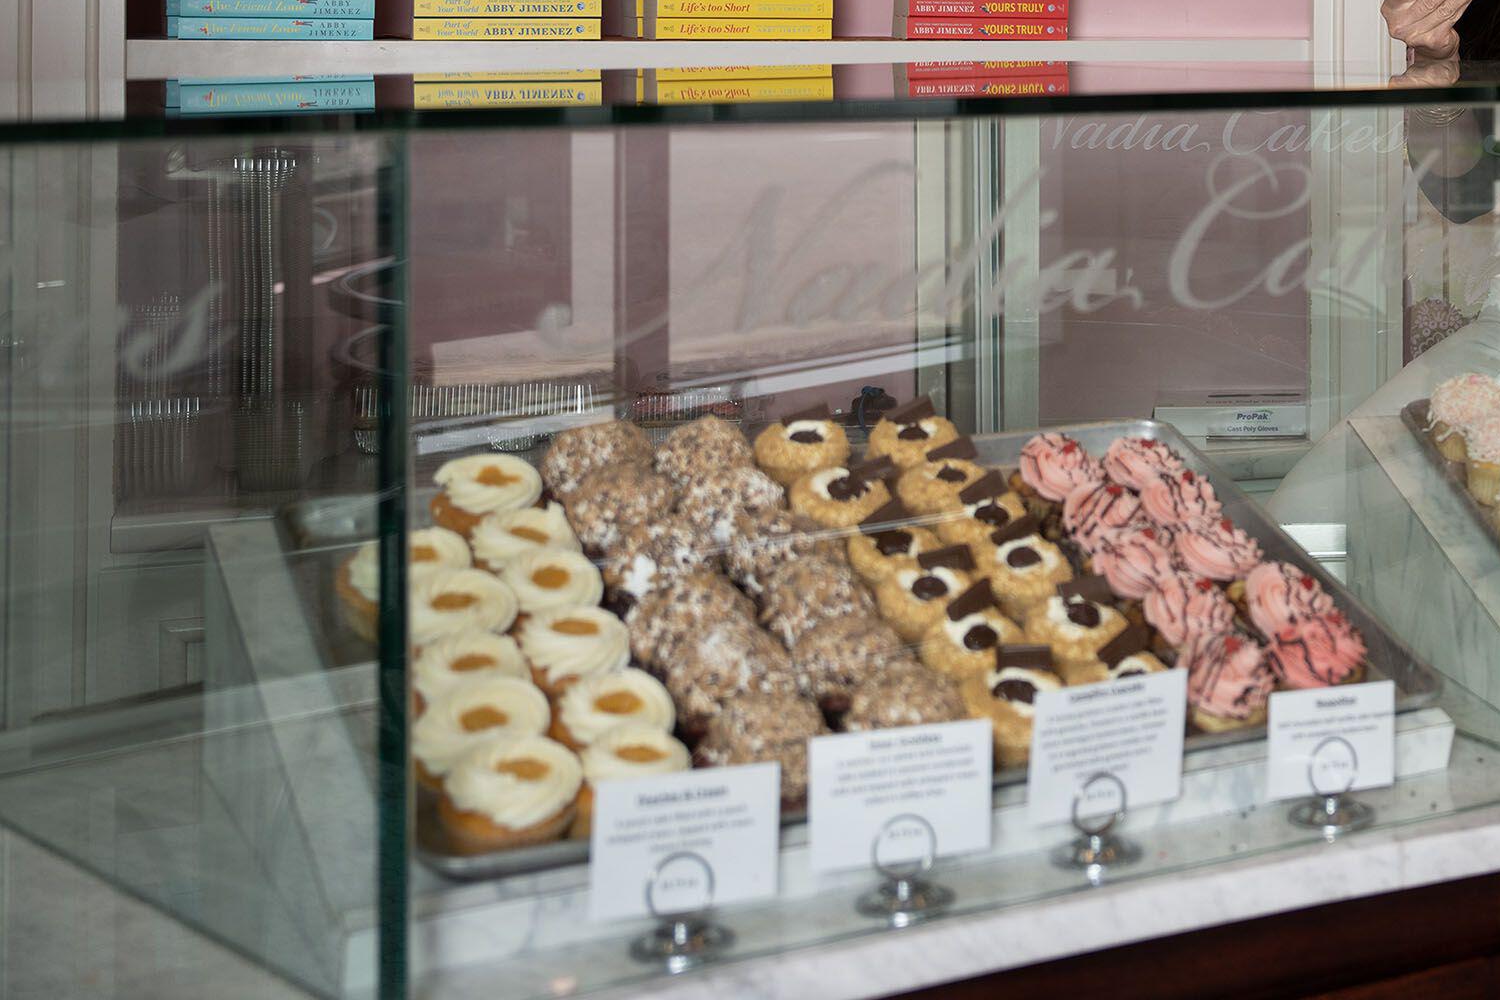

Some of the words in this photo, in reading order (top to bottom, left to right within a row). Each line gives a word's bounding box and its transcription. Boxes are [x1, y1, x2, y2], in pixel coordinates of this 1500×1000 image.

[484, 4, 516, 12] ABBY
[519, 4, 574, 13] JIMENEZ
[708, 3, 723, 12] too
[724, 3, 750, 12] Short
[915, 4, 936, 12] ABBY
[938, 5, 975, 13] JIMENEZ
[985, 2, 1016, 12] YOURS
[1017, 3, 1044, 13] TRULY
[463, 21, 472, 29] of
[707, 25, 722, 33] too
[724, 24, 750, 34] Short
[936, 27, 974, 35] JIMENEZ
[984, 24, 1014, 34] YOURS
[1016, 25, 1043, 35] TRULY
[483, 27, 515, 35] ABBY
[518, 27, 573, 35] JIMENEZ
[1236, 413, 1268, 421] ProPak
